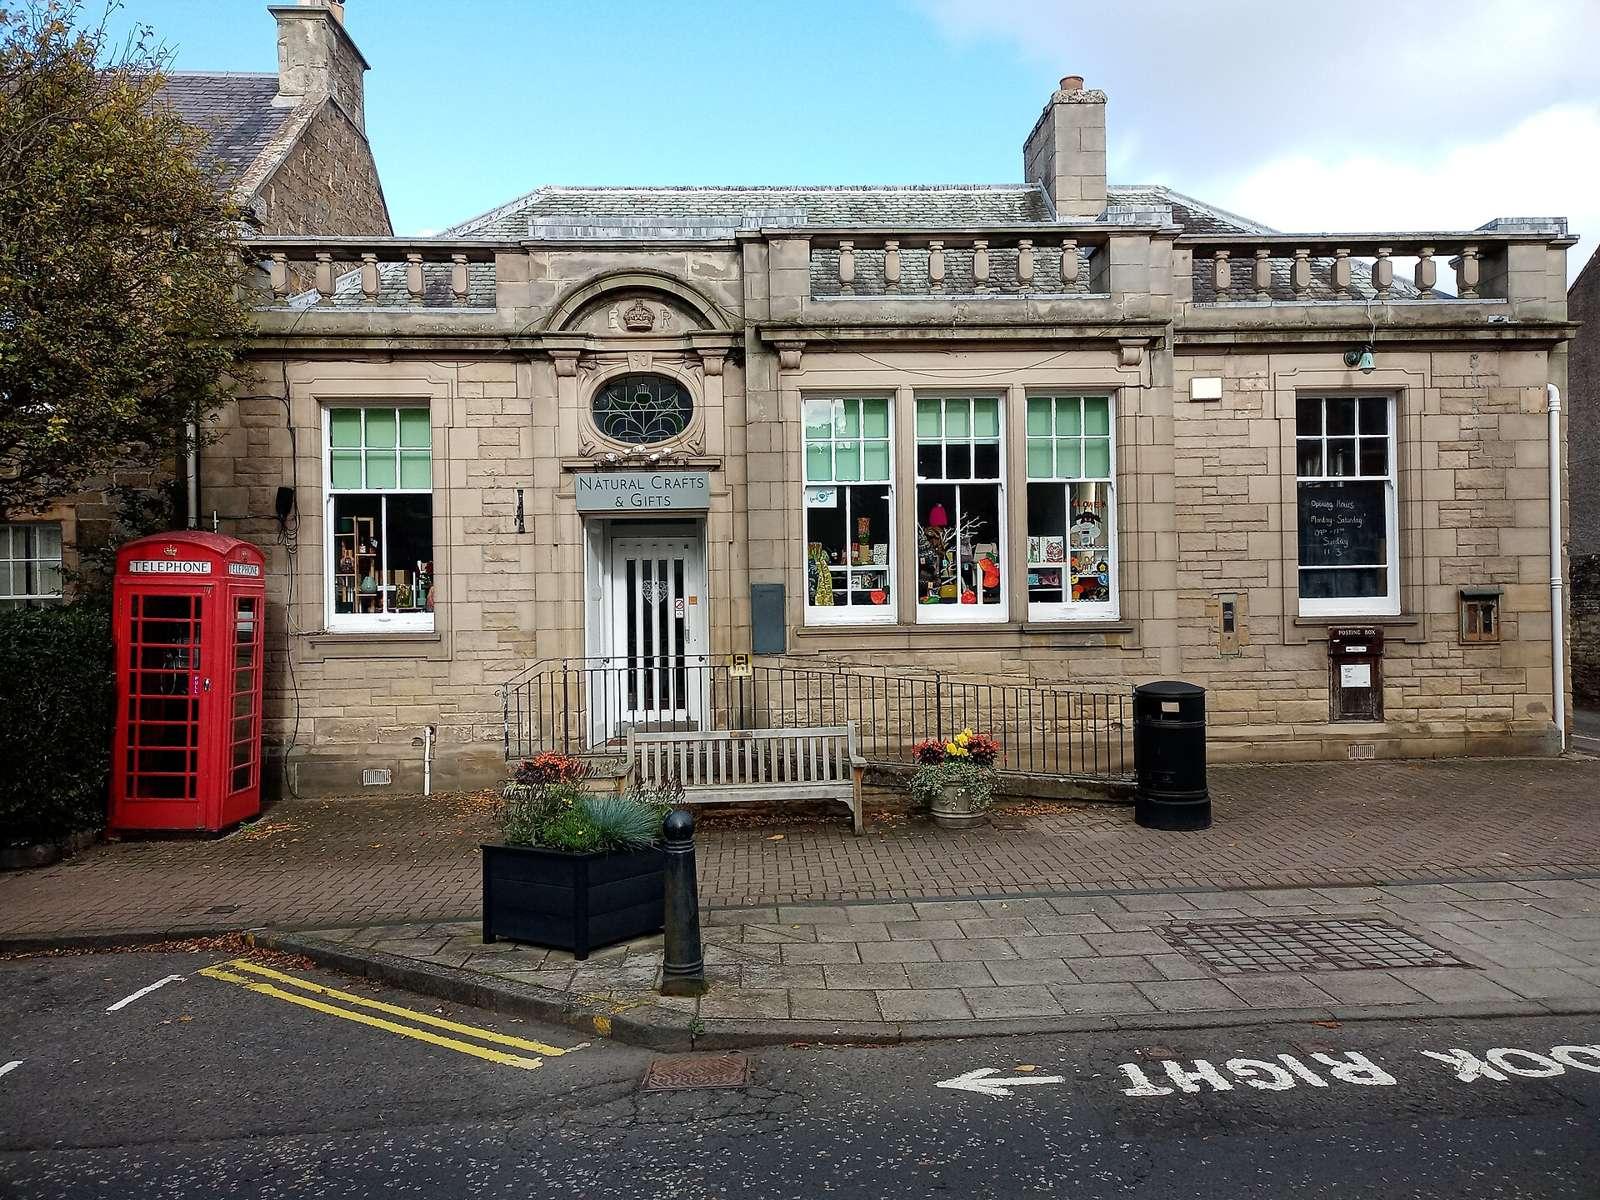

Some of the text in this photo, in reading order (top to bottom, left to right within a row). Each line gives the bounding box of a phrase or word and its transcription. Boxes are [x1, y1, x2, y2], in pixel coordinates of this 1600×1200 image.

[607, 310, 673, 329] E R
[579, 475, 704, 491] NATURAL CRAFTS
[615, 493, 671, 507] & GIFTS
[132, 561, 209, 573] TELEPHONE
[1118, 1044, 1600, 1097] OOK RIGHT
